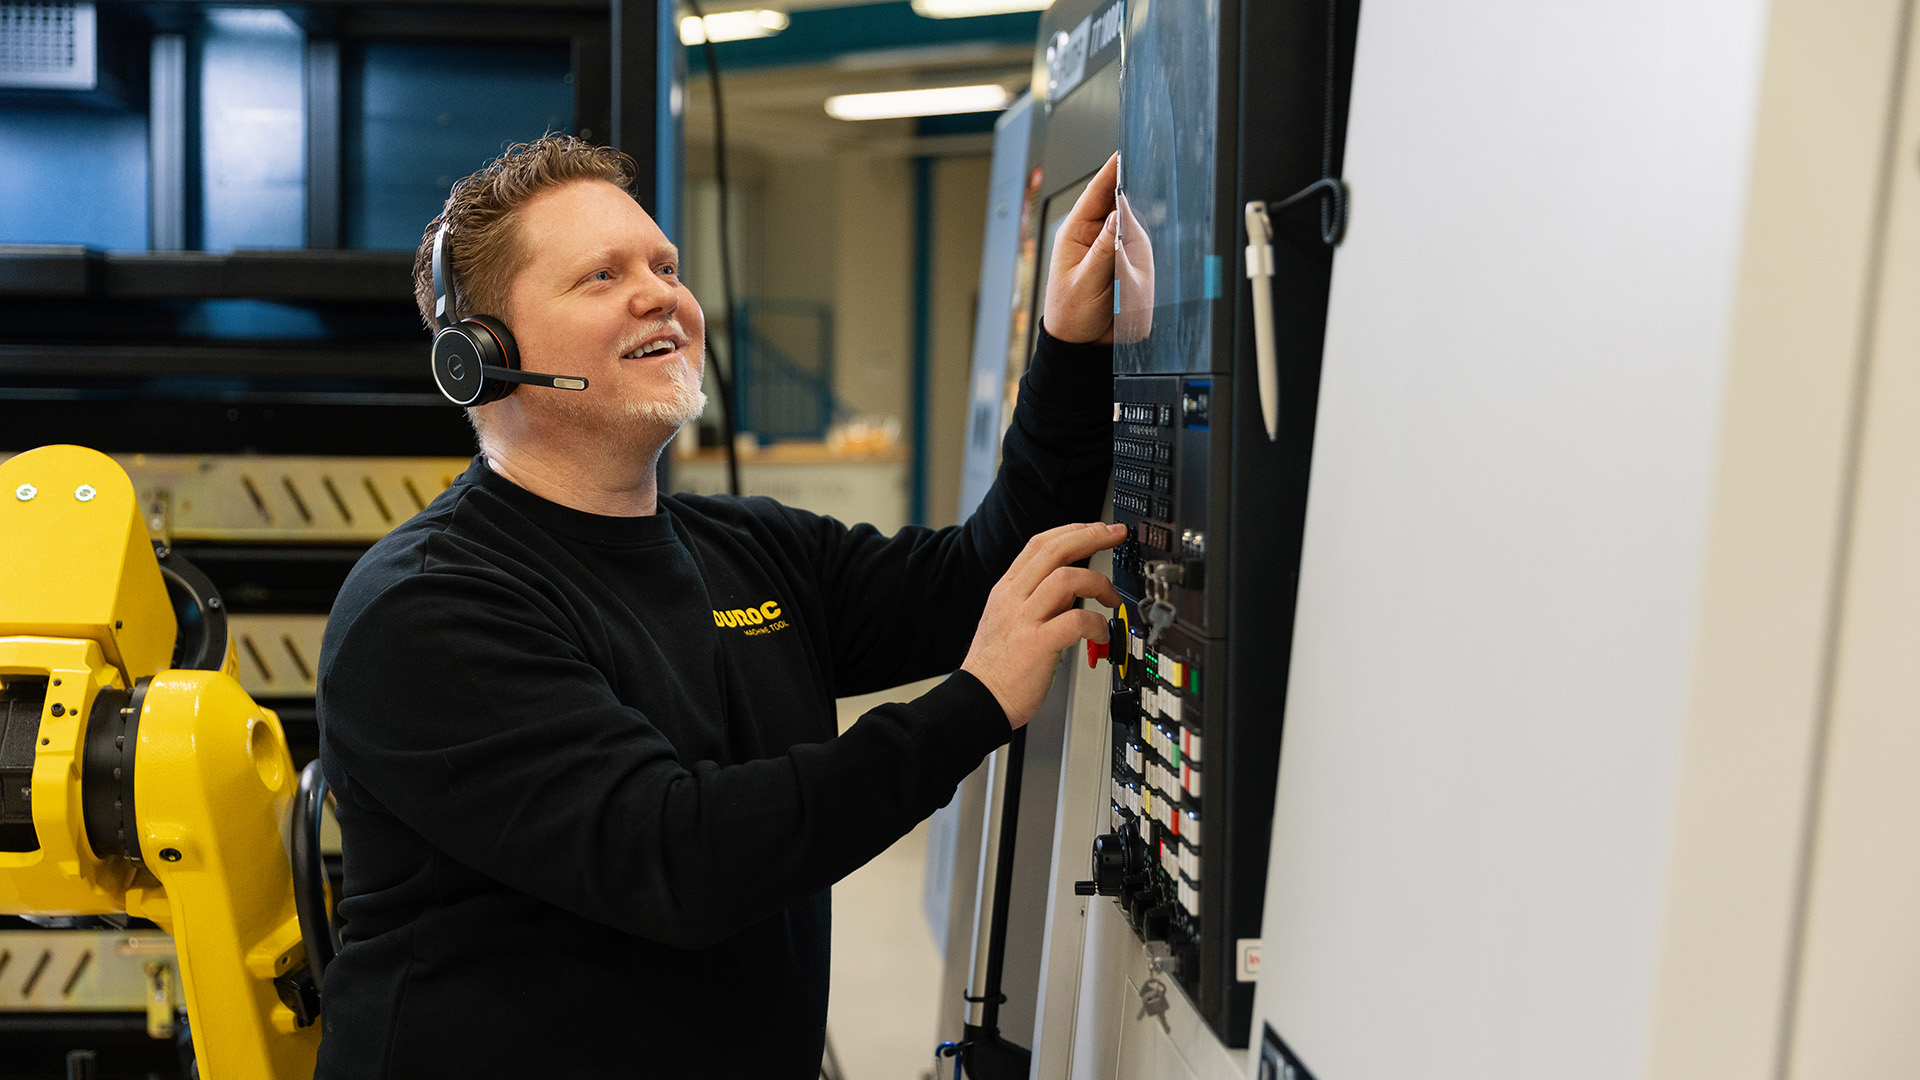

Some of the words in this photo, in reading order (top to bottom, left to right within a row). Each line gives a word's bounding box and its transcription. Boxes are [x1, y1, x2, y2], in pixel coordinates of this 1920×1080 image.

[712, 600, 781, 628] DUROC
[743, 626, 771, 636] MACHINE
[769, 620, 789, 631] TOOL
